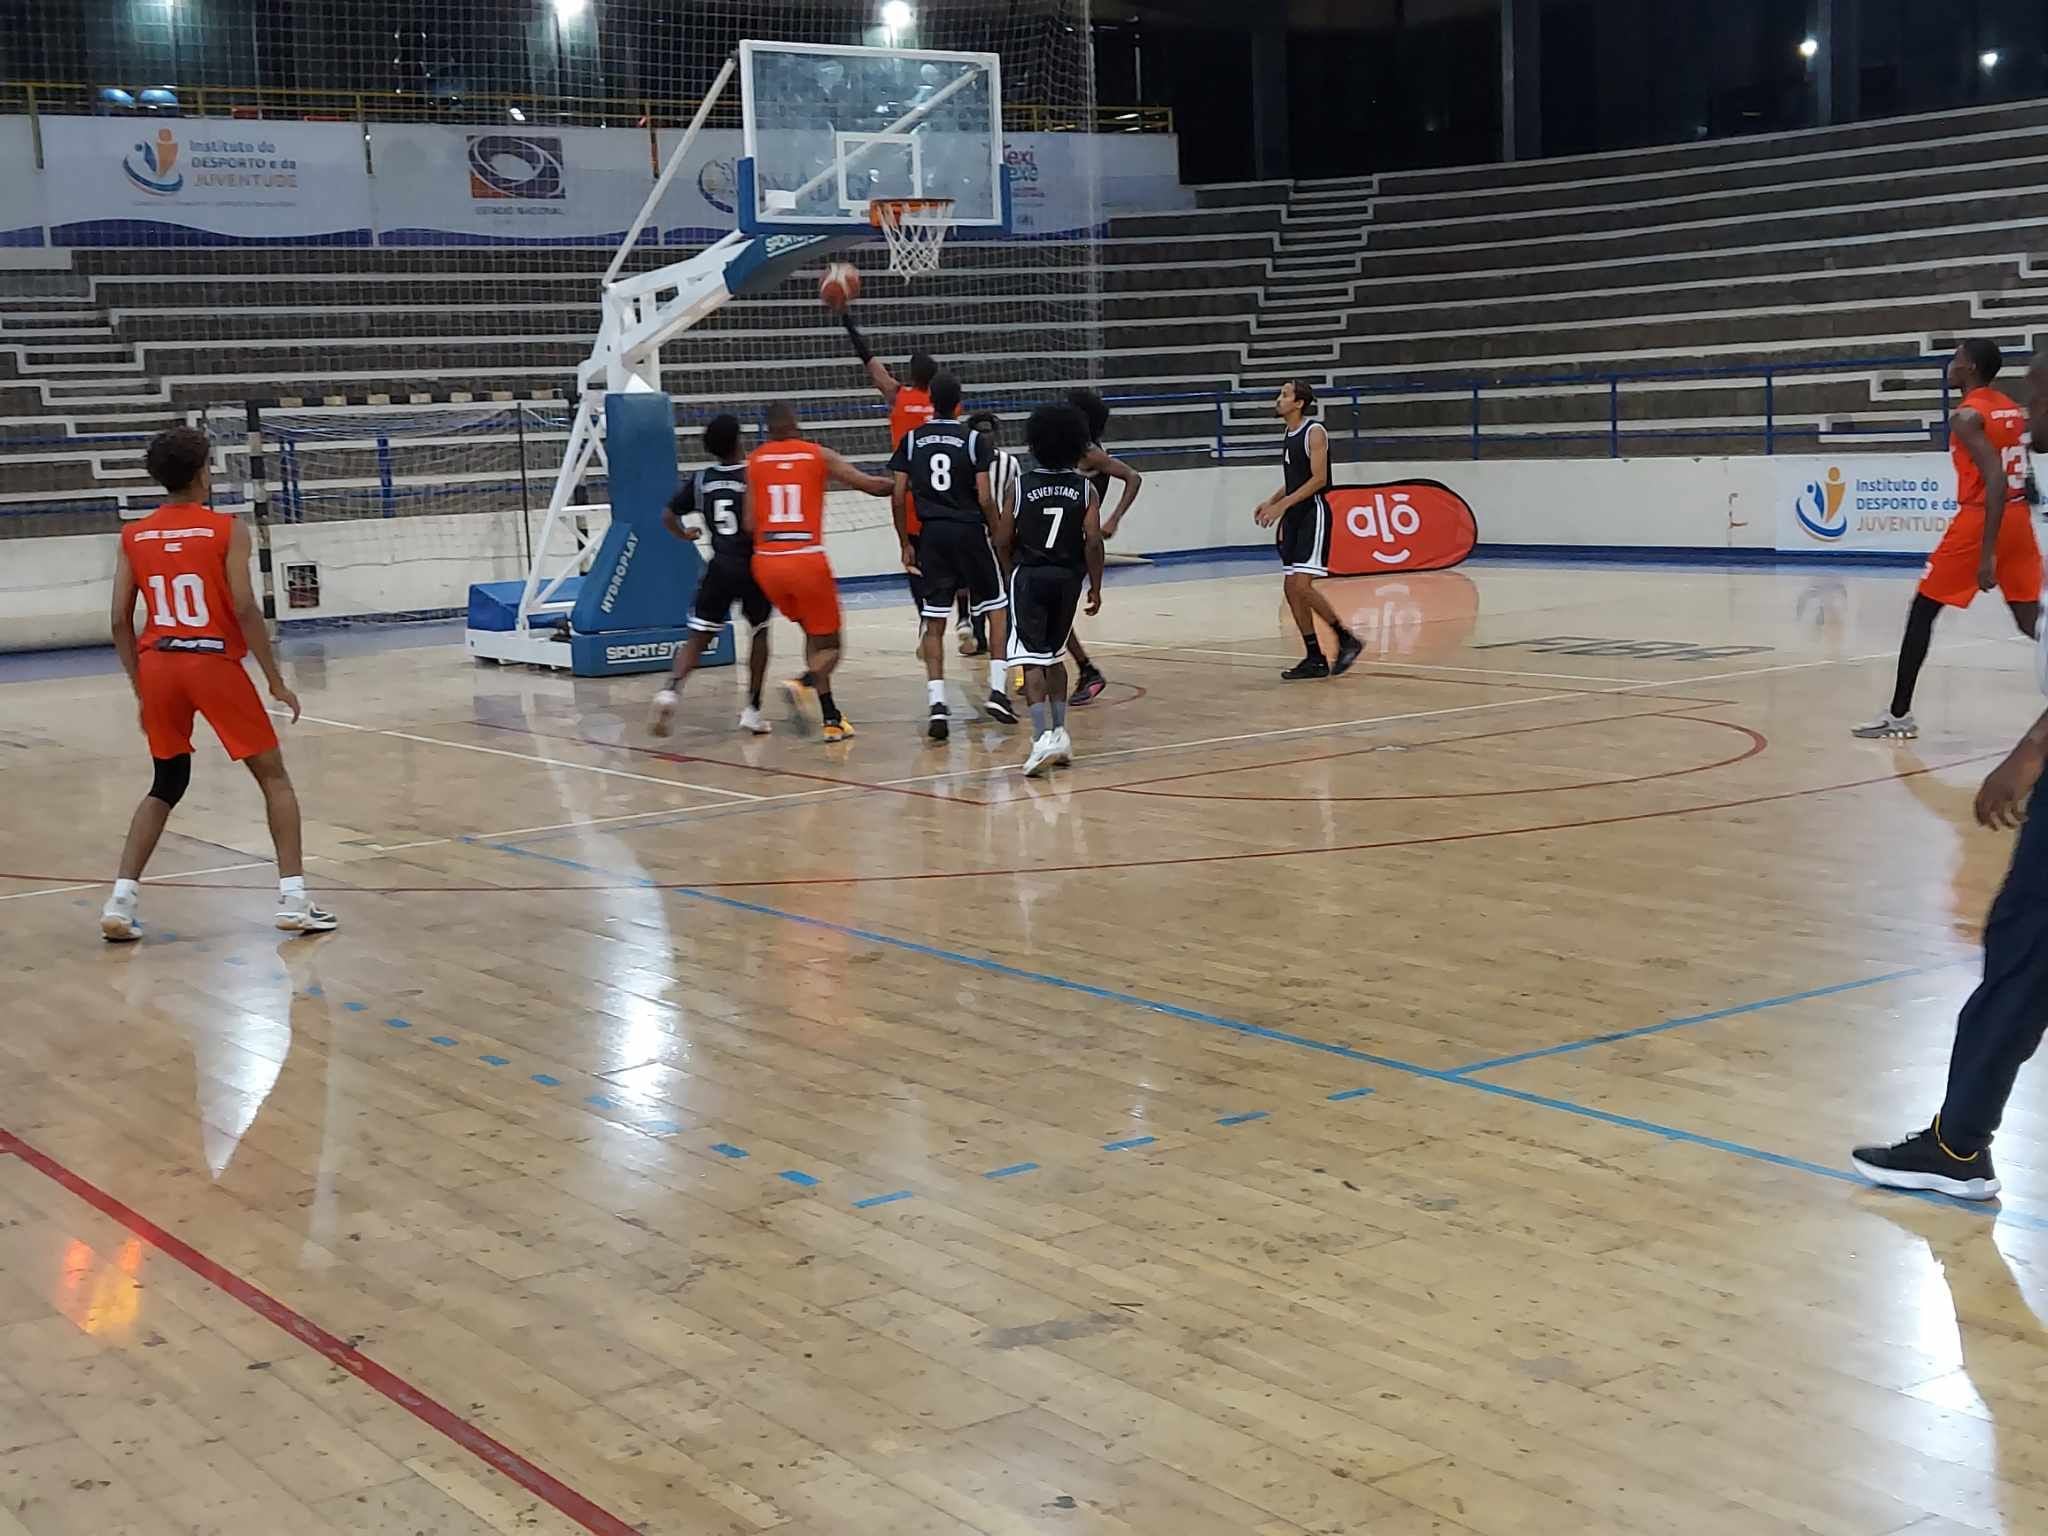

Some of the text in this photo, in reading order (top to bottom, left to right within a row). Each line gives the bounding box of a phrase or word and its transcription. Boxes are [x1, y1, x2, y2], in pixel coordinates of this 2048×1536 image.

[192, 157, 266, 169] DESPORTO
[193, 174, 298, 188] JUVENTUDE
[929, 453, 951, 491] 8
[1856, 478, 1939, 492] Instituto do
[767, 484, 804, 523] 11
[1026, 486, 1080, 502] SEVEN STARS
[1856, 497, 1958, 510] DESPORTO e da
[713, 499, 738, 535] 5
[1043, 507, 1064, 548] 7
[600, 531, 640, 613] HYDROPLAY
[148, 573, 210, 627] 10
